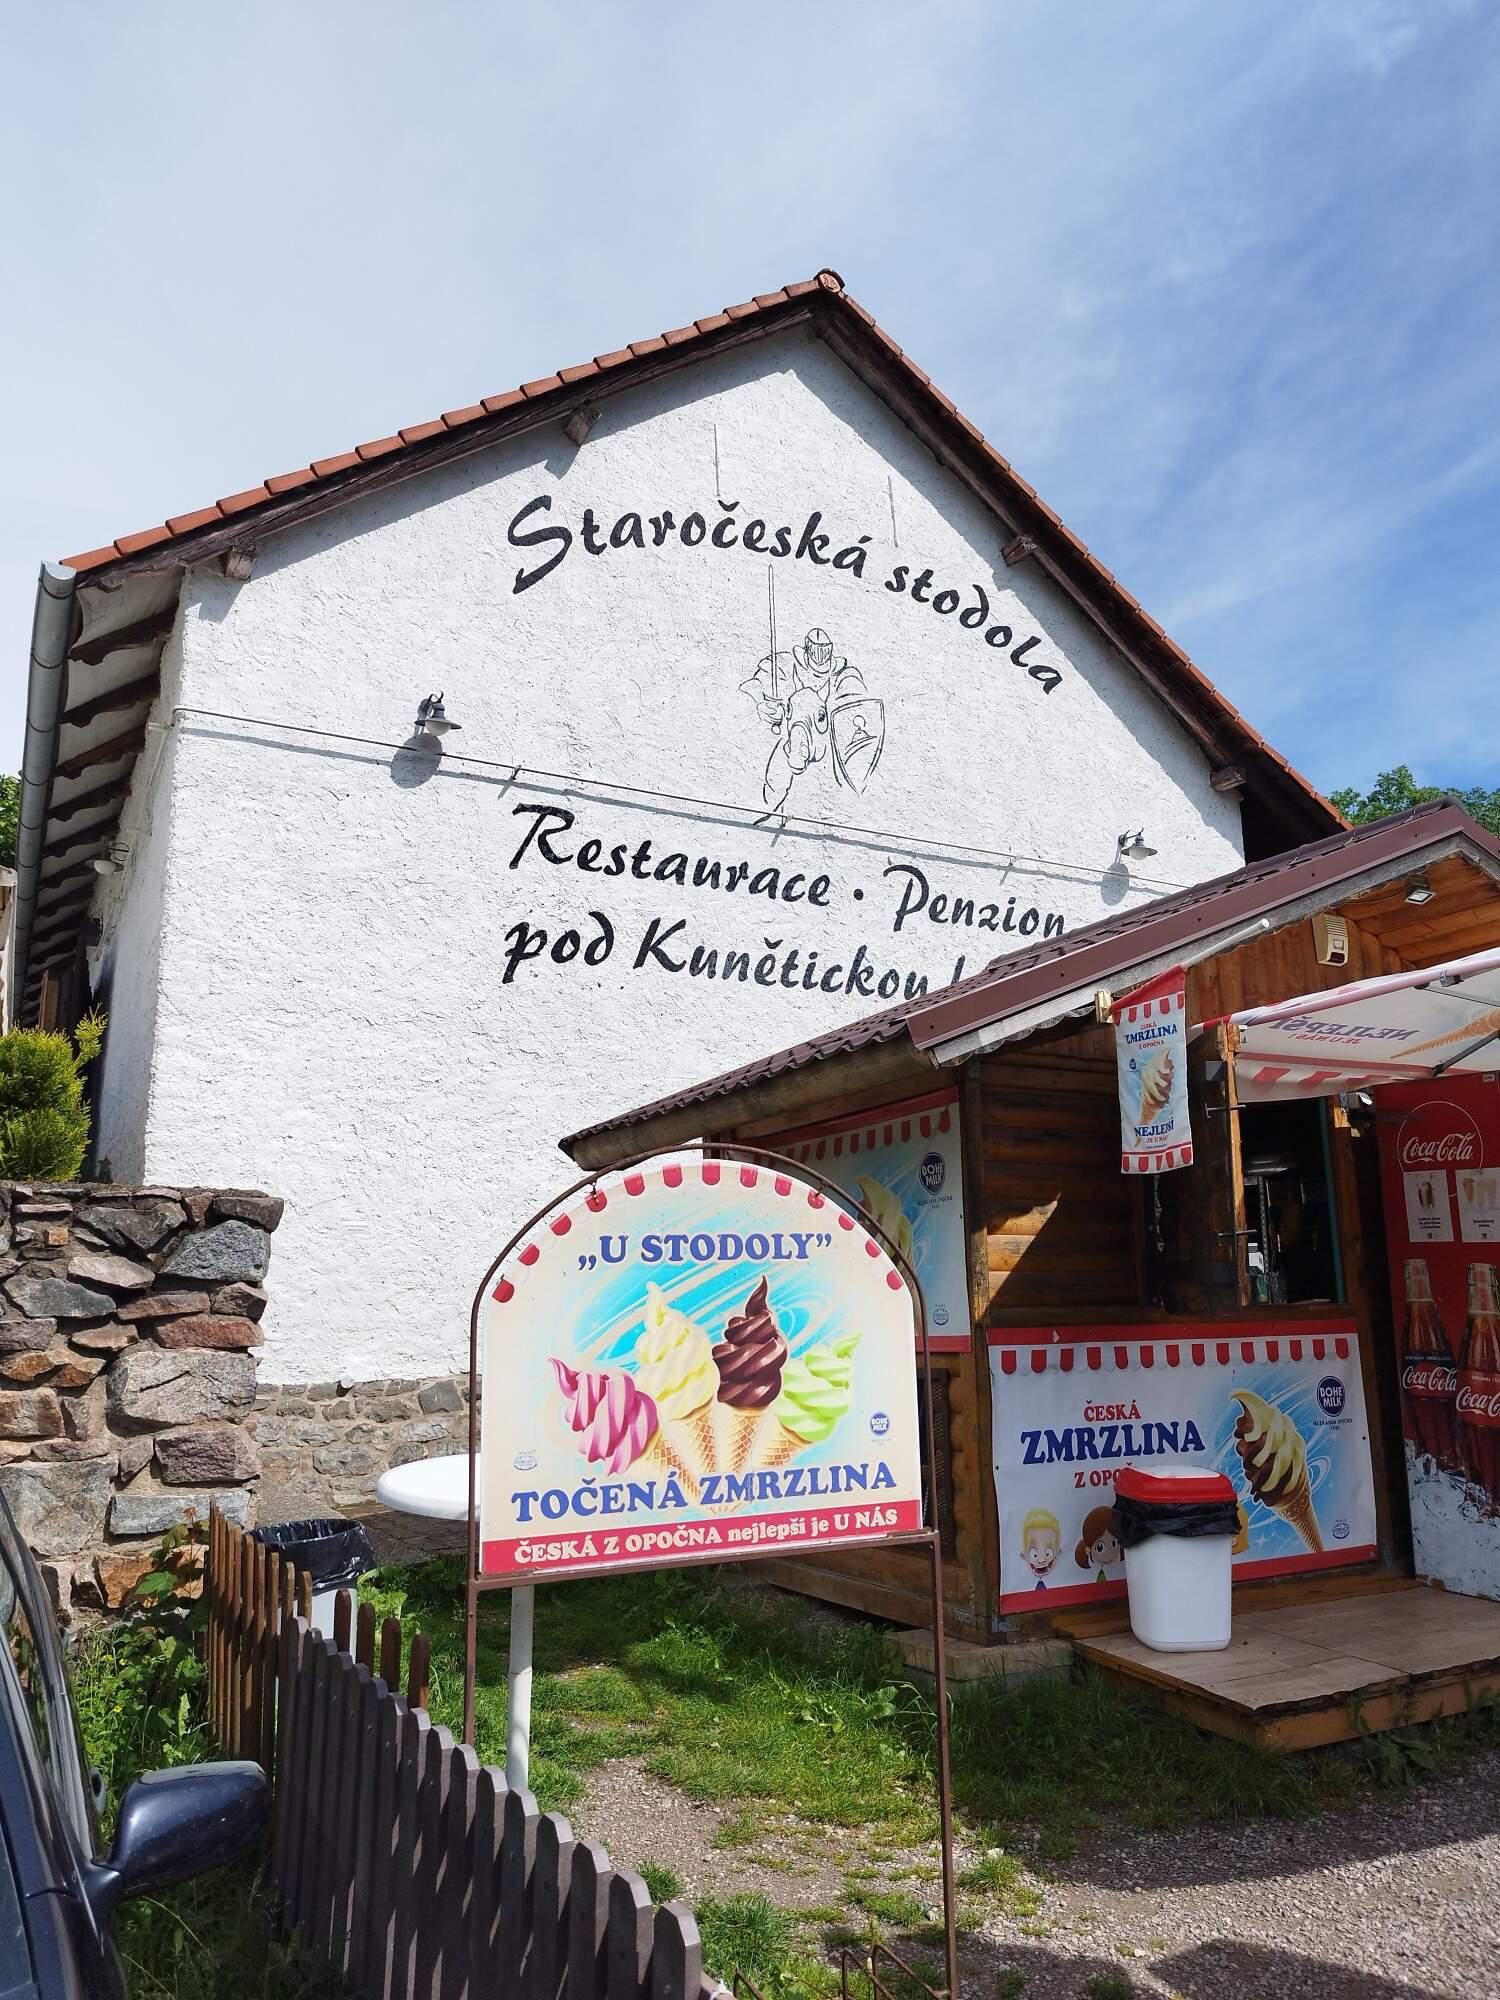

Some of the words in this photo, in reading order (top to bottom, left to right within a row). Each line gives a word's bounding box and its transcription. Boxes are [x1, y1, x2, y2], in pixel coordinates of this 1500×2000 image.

[508, 495, 873, 595] Staročeská
[886, 560, 1065, 695] stodola
[509, 803, 831, 907] Restaurace
[883, 857, 1065, 939] Penzion
[502, 911, 615, 984] pod
[633, 917, 928, 1001] Kunětickou
[1125, 1024, 1177, 1044] ZMRZLINA
[1403, 1133, 1476, 1163] Coca-Cola
[1320, 1387, 1344, 1398] BOHE
[1402, 1366, 1457, 1391] Coca-Cola
[1083, 1400, 1142, 1423] ČESKÁ
[1323, 1397, 1342, 1408] MILK
[1456, 1386, 1500, 1416] Coca-C
[1021, 1420, 1206, 1465] ZMRZLINA
[511, 1471, 688, 1522] TOČENÁ
[699, 1461, 897, 1505] ZMRZLINA
[1074, 1471, 1086, 1489] Z
[514, 1534, 599, 1565] ČESKÁ
[604, 1536, 619, 1556] Z
[625, 1523, 723, 1553] OPOČNA
[727, 1515, 806, 1544] nejlepší
[810, 1514, 829, 1536] je
[833, 1511, 850, 1530] U
[855, 1505, 899, 1528] NÁS
